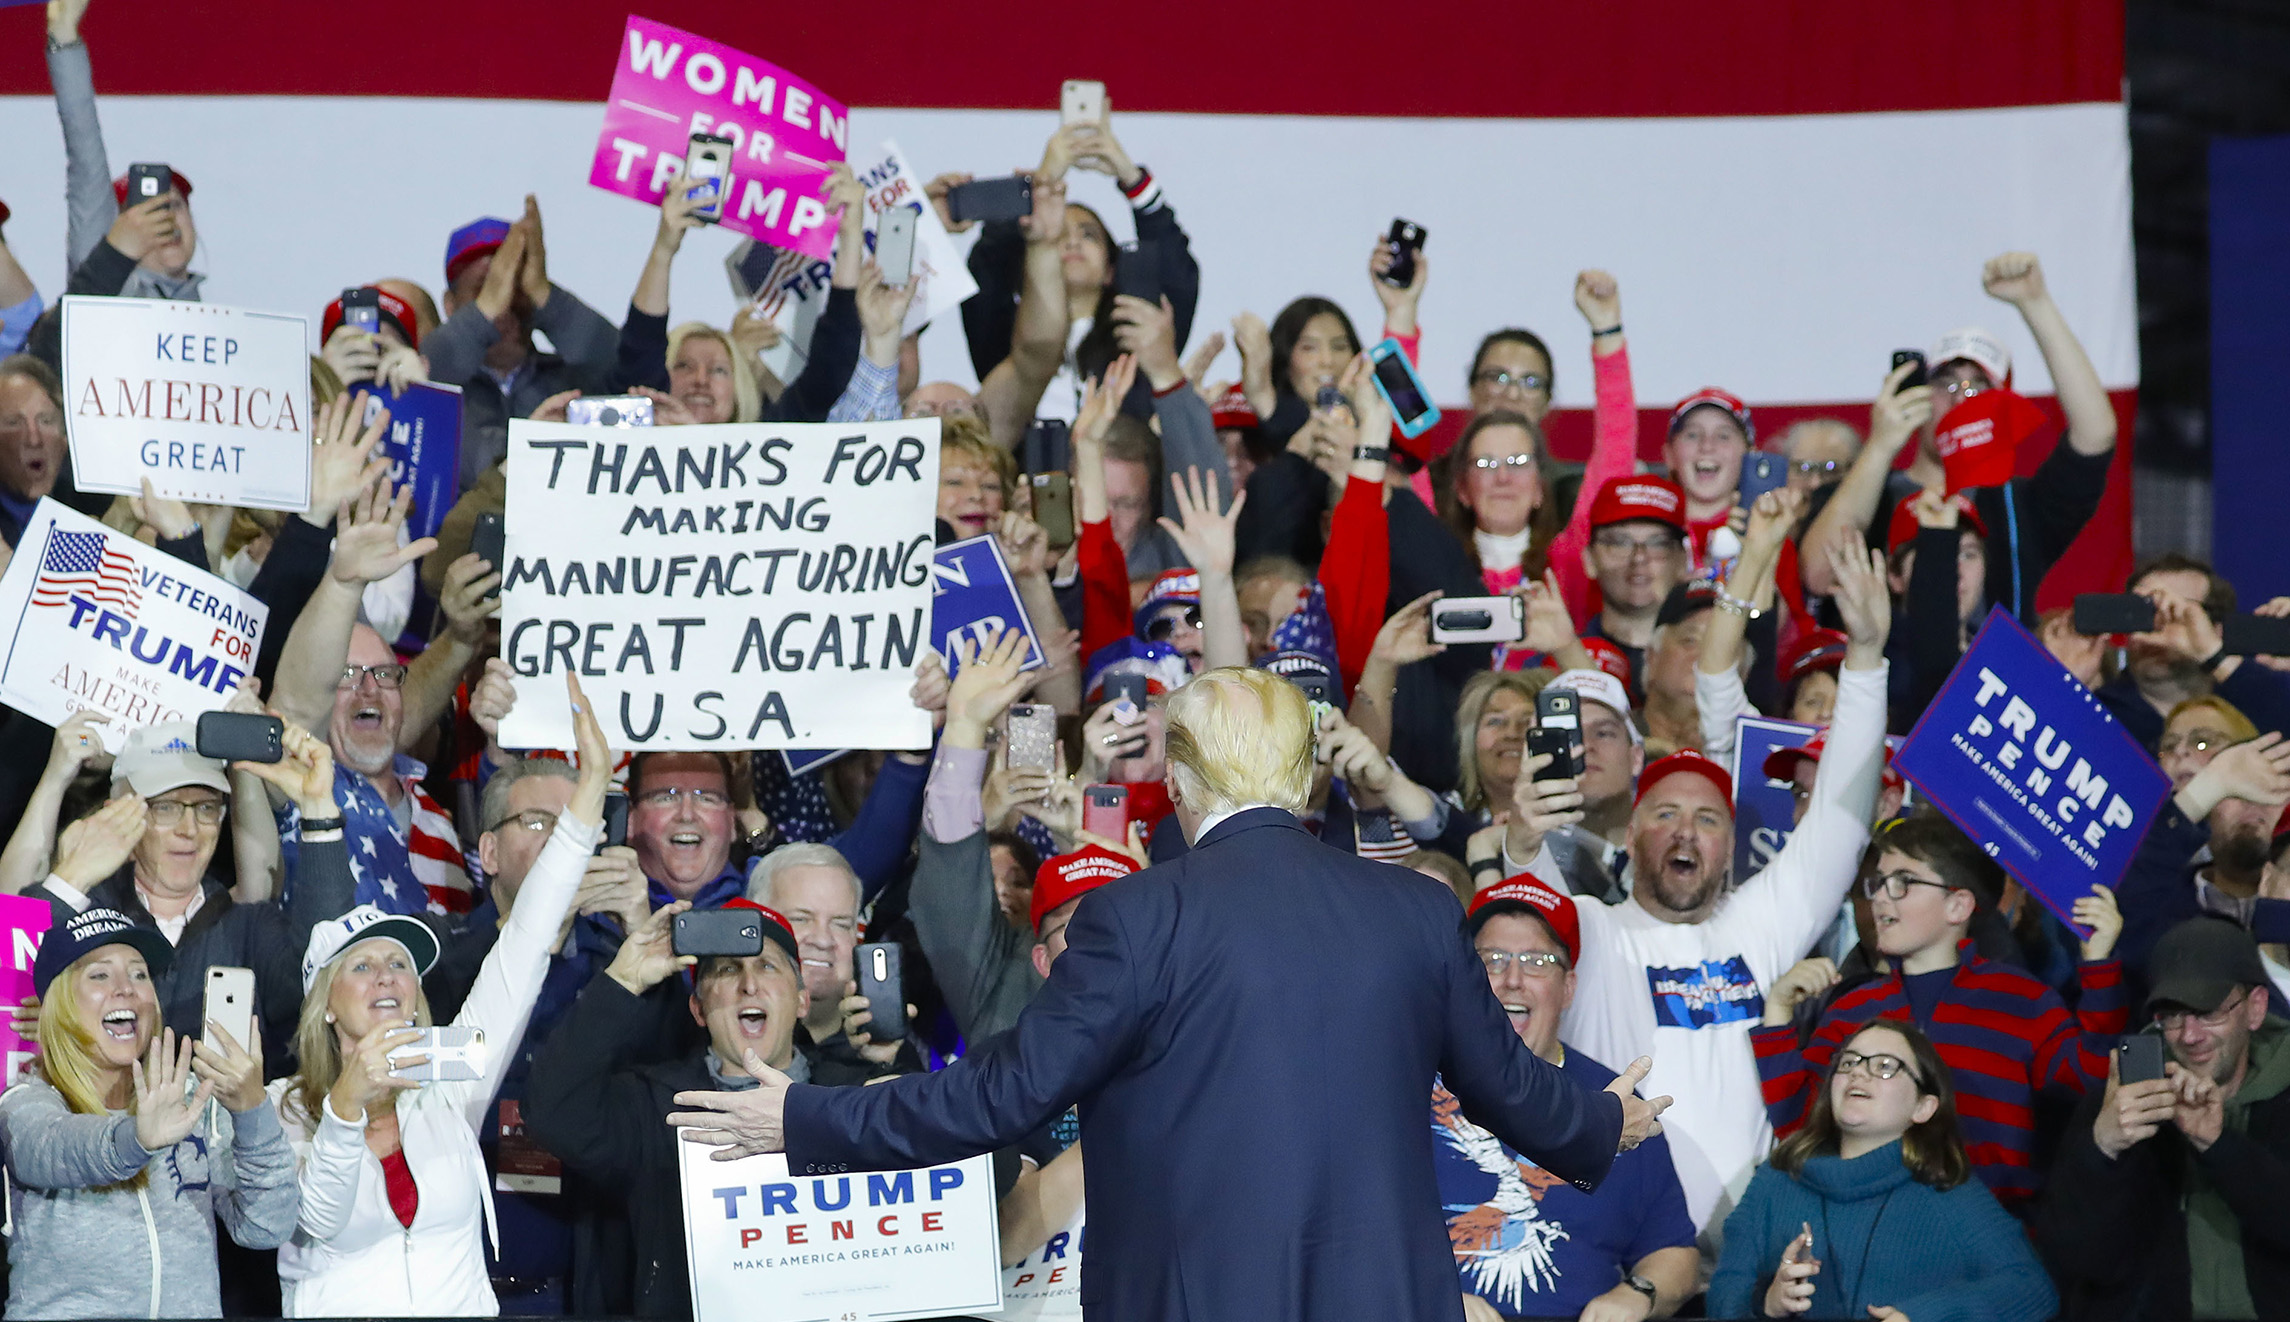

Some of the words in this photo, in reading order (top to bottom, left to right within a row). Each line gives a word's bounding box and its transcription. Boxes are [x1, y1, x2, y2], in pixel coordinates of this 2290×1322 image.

[629, 29, 847, 152] WOMEN
[689, 111, 774, 164] FOR
[612, 137, 826, 237] TRMP
[869, 178, 911, 213] FOR
[156, 332, 239, 365] KEEP
[77, 376, 301, 433] AMERICA
[140, 439, 246, 475] GREAT
[528, 437, 794, 496] THANKS
[823, 435, 926, 487] FOR
[620, 496, 831, 537] MAKING
[502, 534, 932, 599] MANUFACTURING
[139, 565, 259, 640] VETERANS
[68, 594, 246, 695] TRUMP
[209, 627, 253, 666] FOR
[508, 617, 706, 678] GREAT
[731, 607, 923, 674] AGAIN
[51, 662, 183, 726] AMERI
[115, 666, 162, 697] MAKE
[619, 691, 811, 743] U.S.A.
[1974, 666, 2135, 830] TRUMP
[1951, 732, 1984, 765] MAKE
[1979, 760, 2029, 807] AMERICA
[2027, 802, 2065, 837] GREAT
[2060, 833, 2099, 871] AGAIN!
[1967, 713, 2107, 850] PENCE
[1058, 857, 1088, 875] MAKE
[1088, 856, 1131, 874] AMERICA
[1065, 866, 1099, 882] GREAT
[1983, 841, 2001, 858] 45
[712, 1167, 965, 1219] TRUMP
[732, 1258, 774, 1271] MAKE
[779, 1252, 846, 1266] AMERICA
[851, 1246, 898, 1260] GREAT
[902, 1240, 956, 1255] AGAIN!
[740, 1211, 944, 1249] PENCE
[840, 1312, 857, 1322] 45
